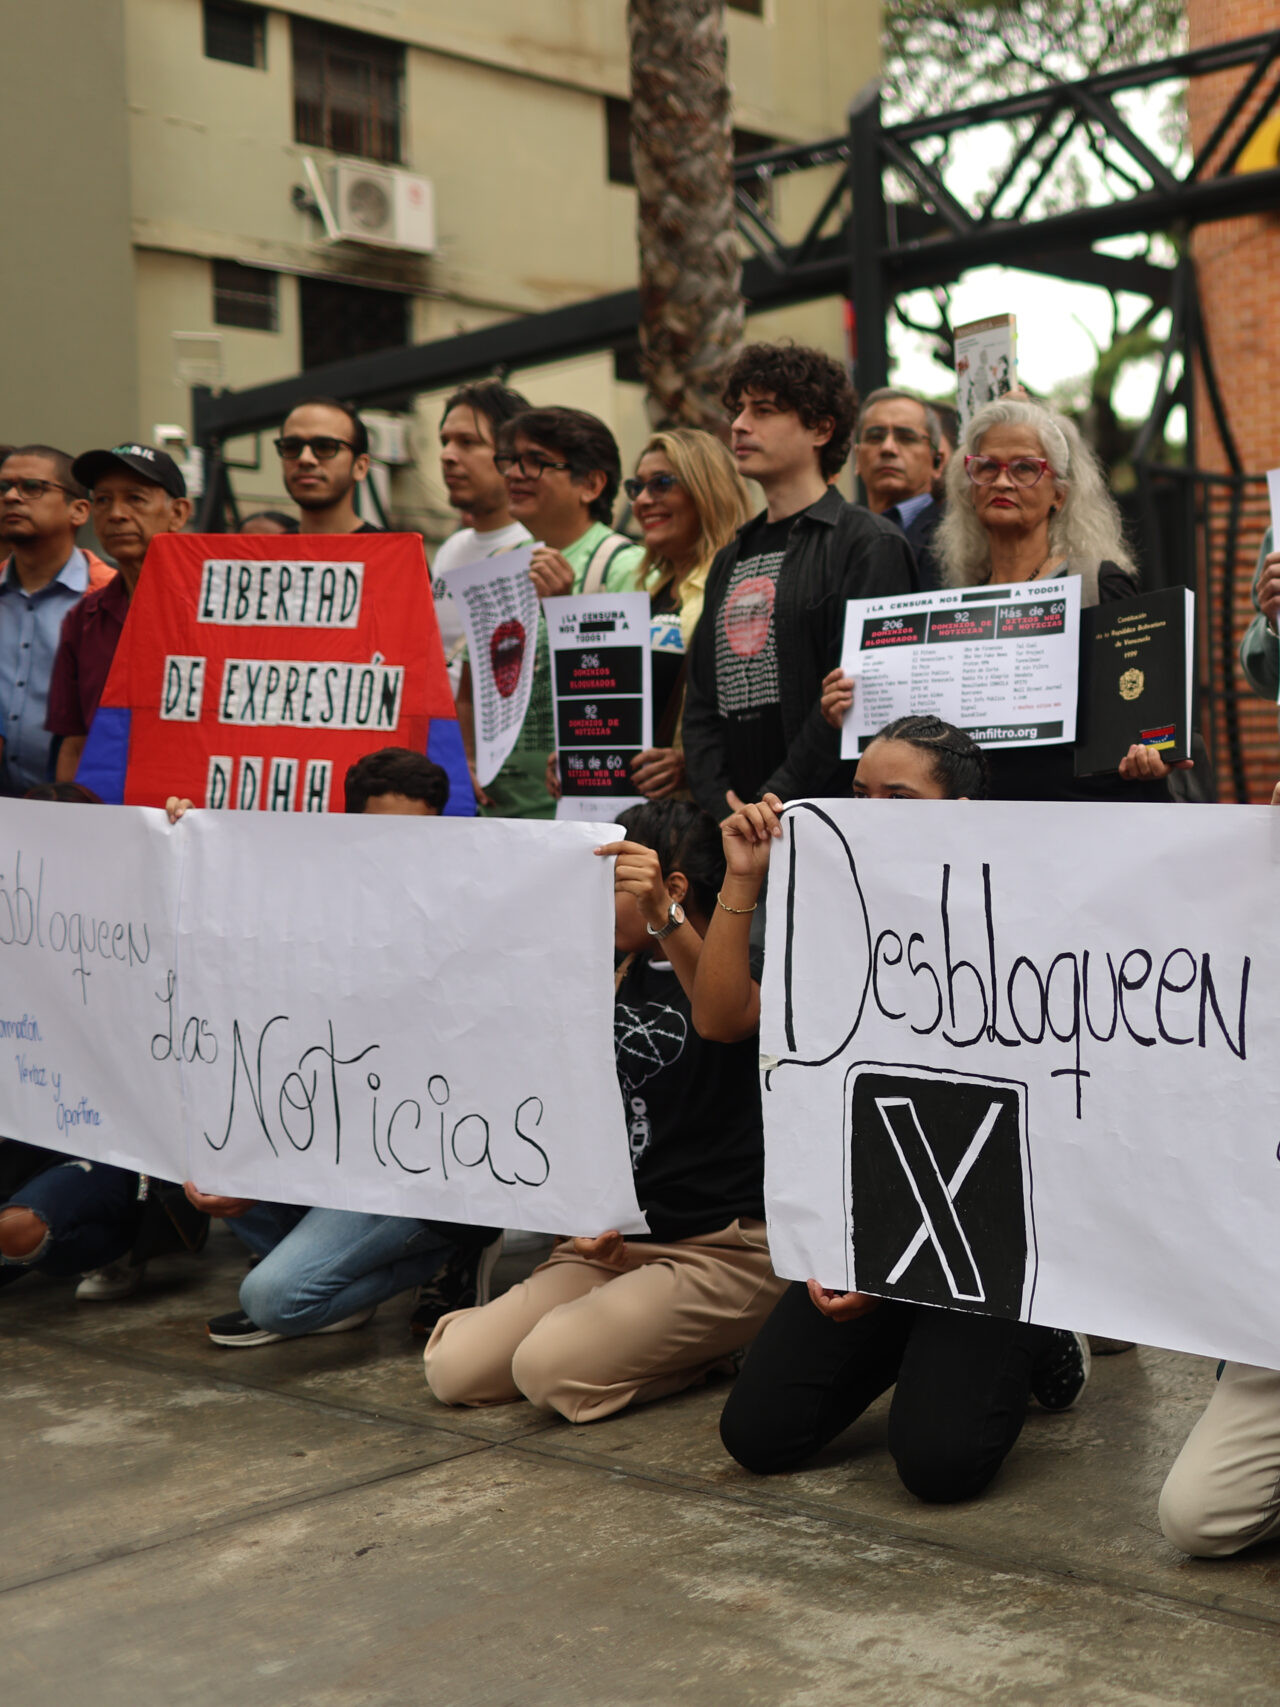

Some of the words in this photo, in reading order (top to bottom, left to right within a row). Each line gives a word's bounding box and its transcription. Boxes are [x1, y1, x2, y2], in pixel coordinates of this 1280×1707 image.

[202, 565, 358, 622] LIBERTAD
[890, 599, 933, 609] CENSURA
[1029, 607, 1044, 616] de
[1051, 603, 1064, 613] 60
[583, 611, 625, 621] CENSURA
[954, 612, 970, 622] 92
[560, 625, 575, 633] NOS
[622, 622, 629, 630] A
[882, 620, 903, 630] 206
[931, 622, 975, 630] DOMINIOS
[1020, 620, 1062, 630] NOTICIAS
[871, 627, 913, 637] DOMINIOS
[939, 628, 984, 636] NOTICIAS
[865, 635, 918, 646] BLOQUEADOS
[581, 654, 599, 669] 206
[573, 668, 610, 677] DOMINIOS
[570, 679, 616, 688] BLOQUEADOS
[165, 660, 201, 717] DE
[224, 657, 399, 726] EXPRESIÓN
[584, 705, 598, 719] 92
[575, 728, 611, 736] NOTICIAS
[968, 728, 1038, 739] sinfiltro.org
[588, 756, 601, 769] de
[607, 755, 622, 769] 60
[209, 762, 328, 813] DDHH
[150, 968, 218, 1064] Las
